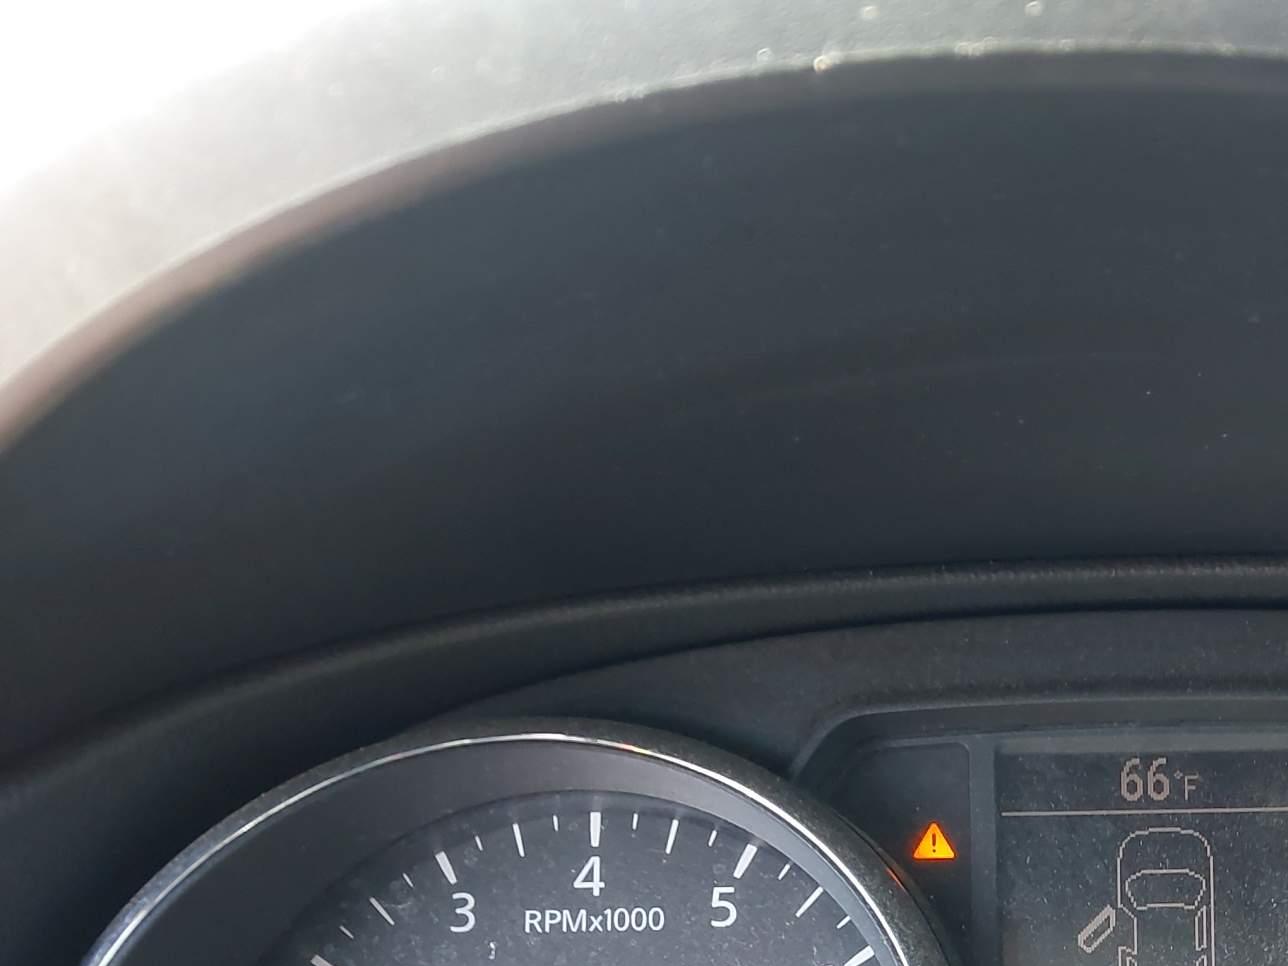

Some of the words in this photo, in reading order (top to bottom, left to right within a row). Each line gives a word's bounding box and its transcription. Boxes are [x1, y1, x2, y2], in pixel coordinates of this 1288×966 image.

[573, 855, 605, 897] 4
[450, 893, 476, 933] 3
[524, 907, 665, 935] RPMx1000
[711, 887, 738, 928] 5
